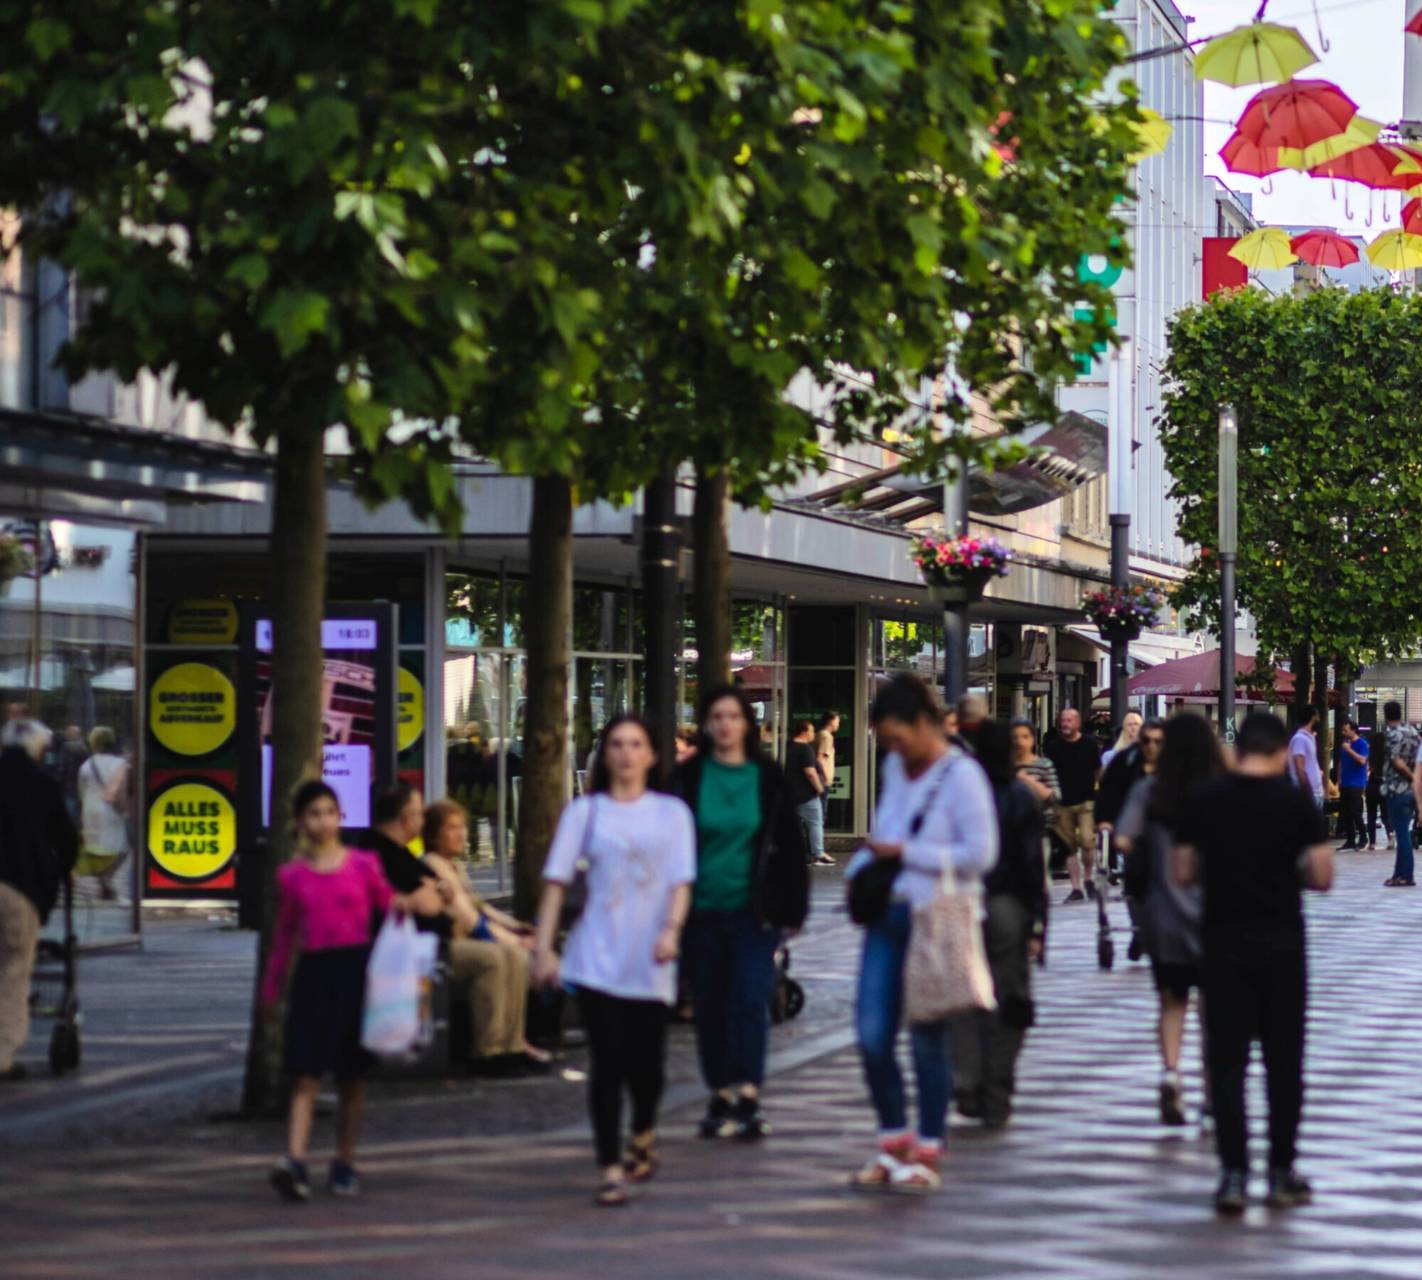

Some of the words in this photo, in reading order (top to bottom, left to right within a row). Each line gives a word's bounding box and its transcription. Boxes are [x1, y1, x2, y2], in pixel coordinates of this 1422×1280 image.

[163, 801, 220, 817] ALLES
[163, 821, 219, 836] MUSS
[163, 840, 219, 855] RAUS
